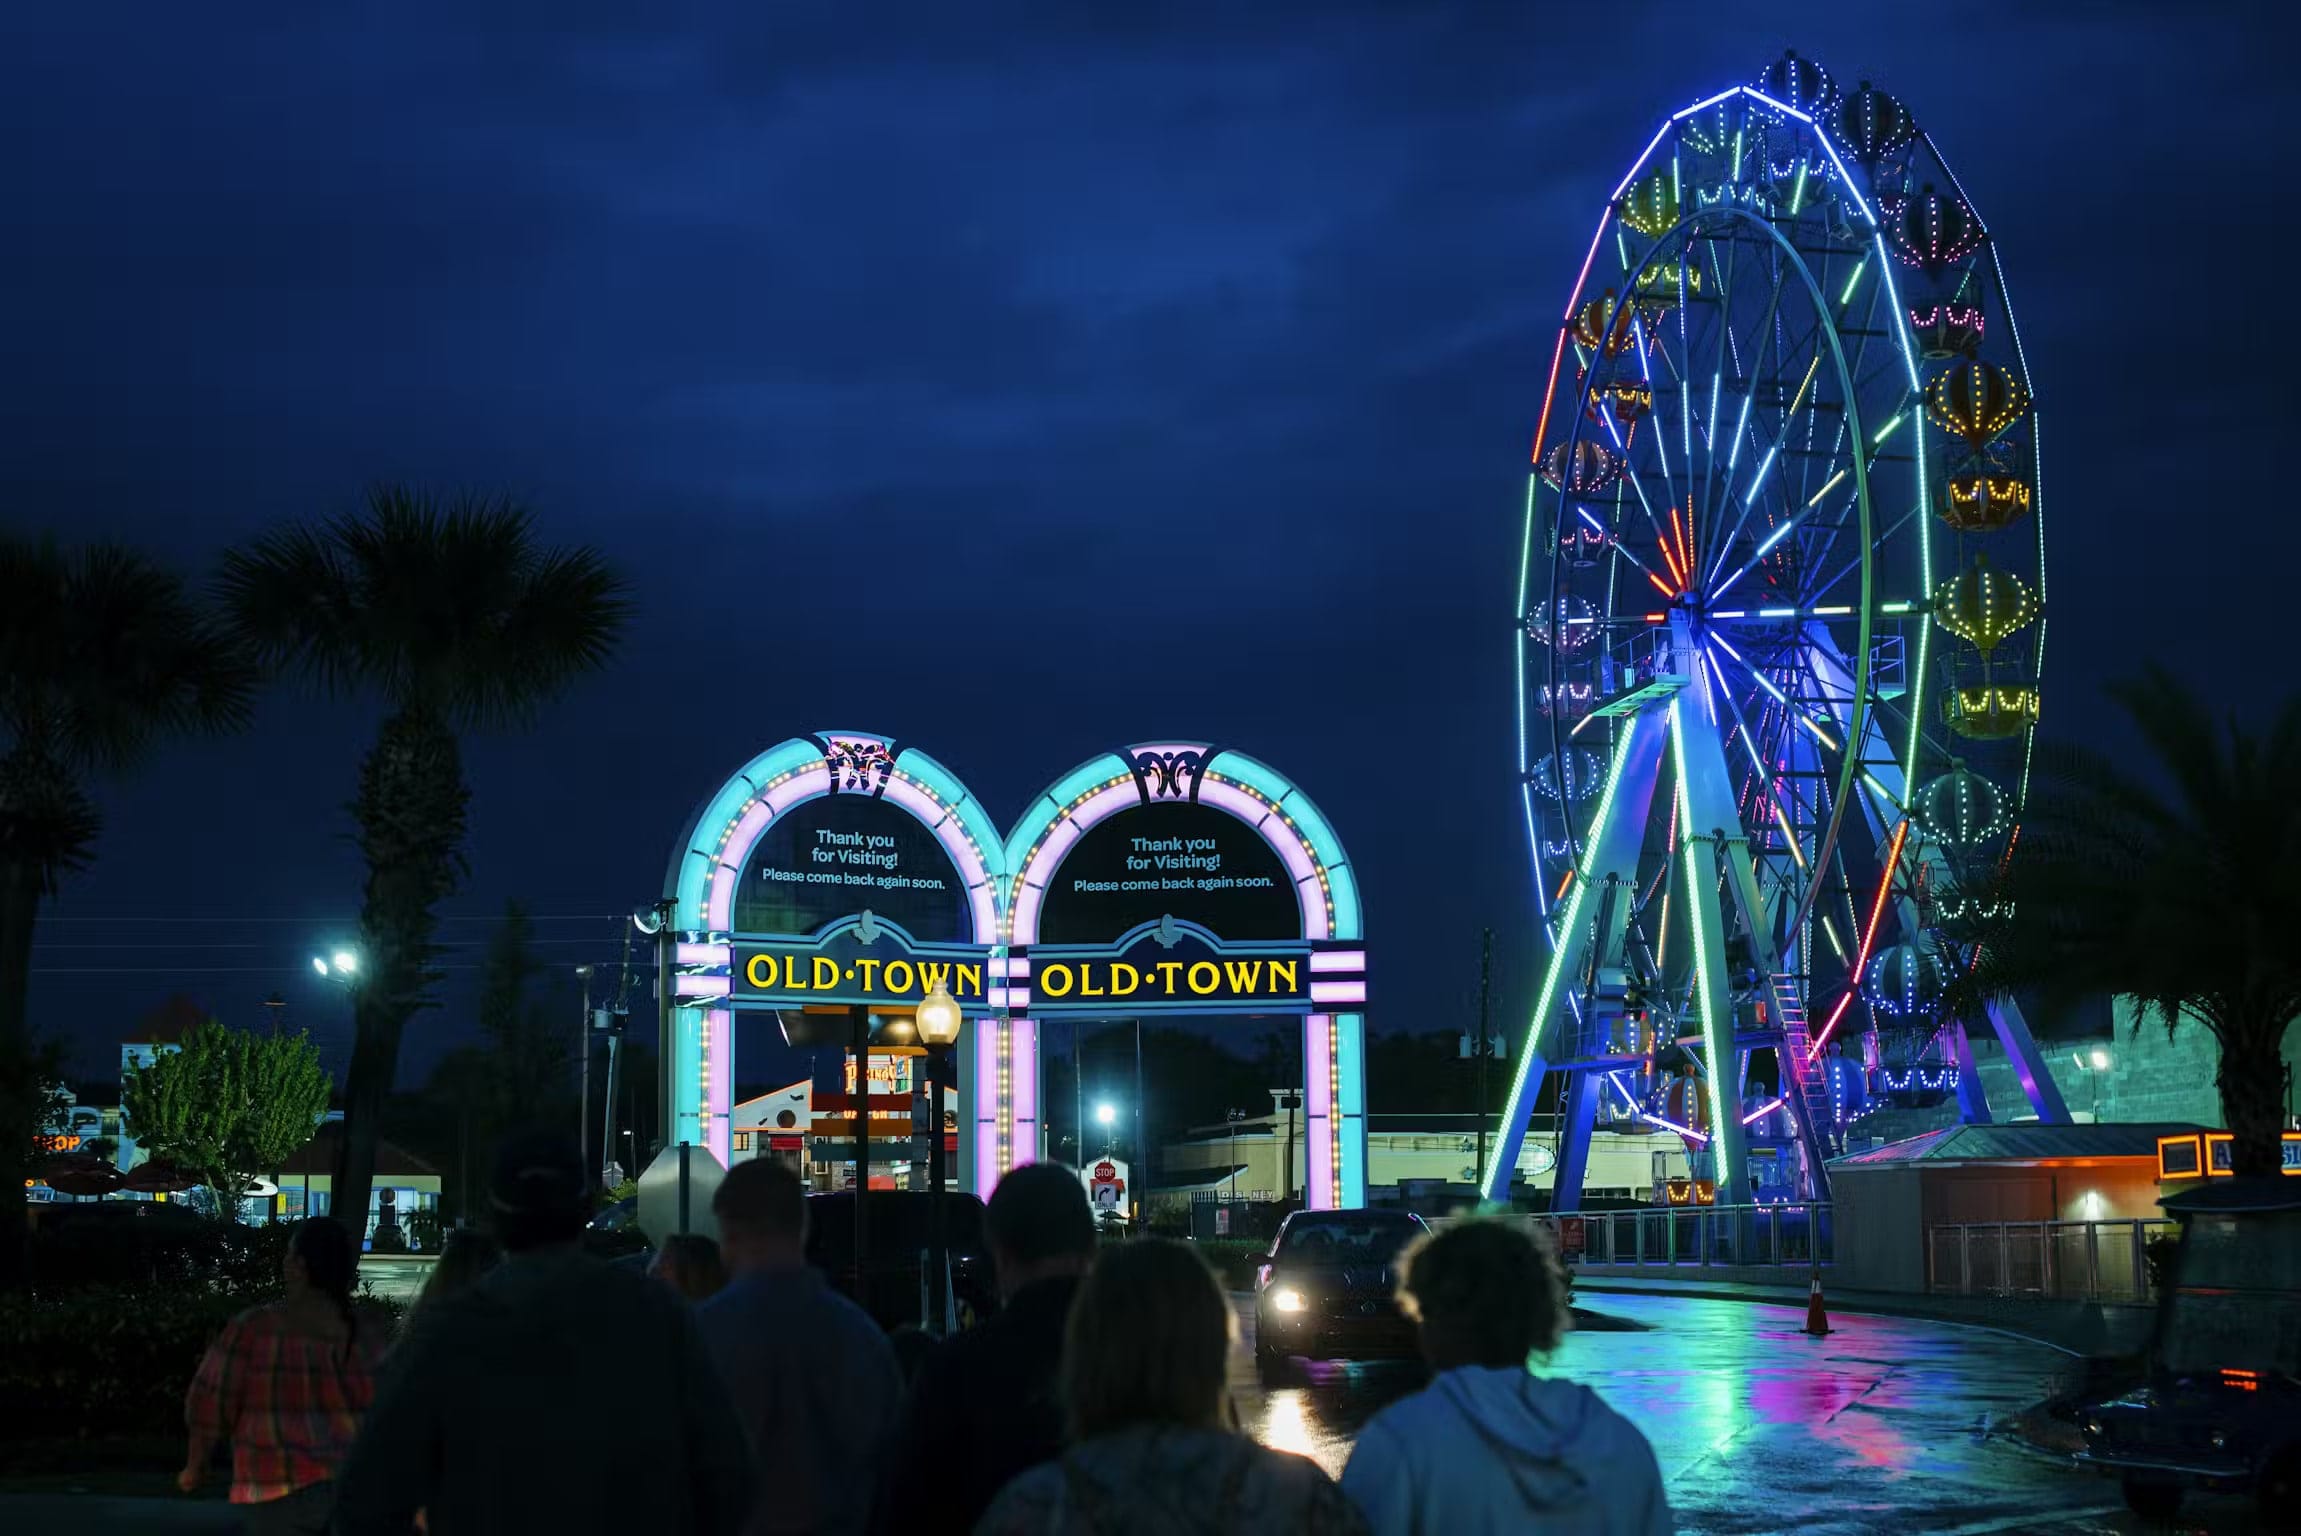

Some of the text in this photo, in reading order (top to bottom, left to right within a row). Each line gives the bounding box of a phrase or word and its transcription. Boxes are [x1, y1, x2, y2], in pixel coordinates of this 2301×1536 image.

[816, 829, 894, 850] Thank you
[1131, 836, 1216, 853] Thank you
[811, 847, 898, 870] for Visiting!
[1126, 853, 1221, 872] for Visiting!
[762, 868, 946, 890] Please come back again soon.
[1074, 876, 1274, 892] Please come back again soon.
[1095, 1168, 1115, 1177] STOP
